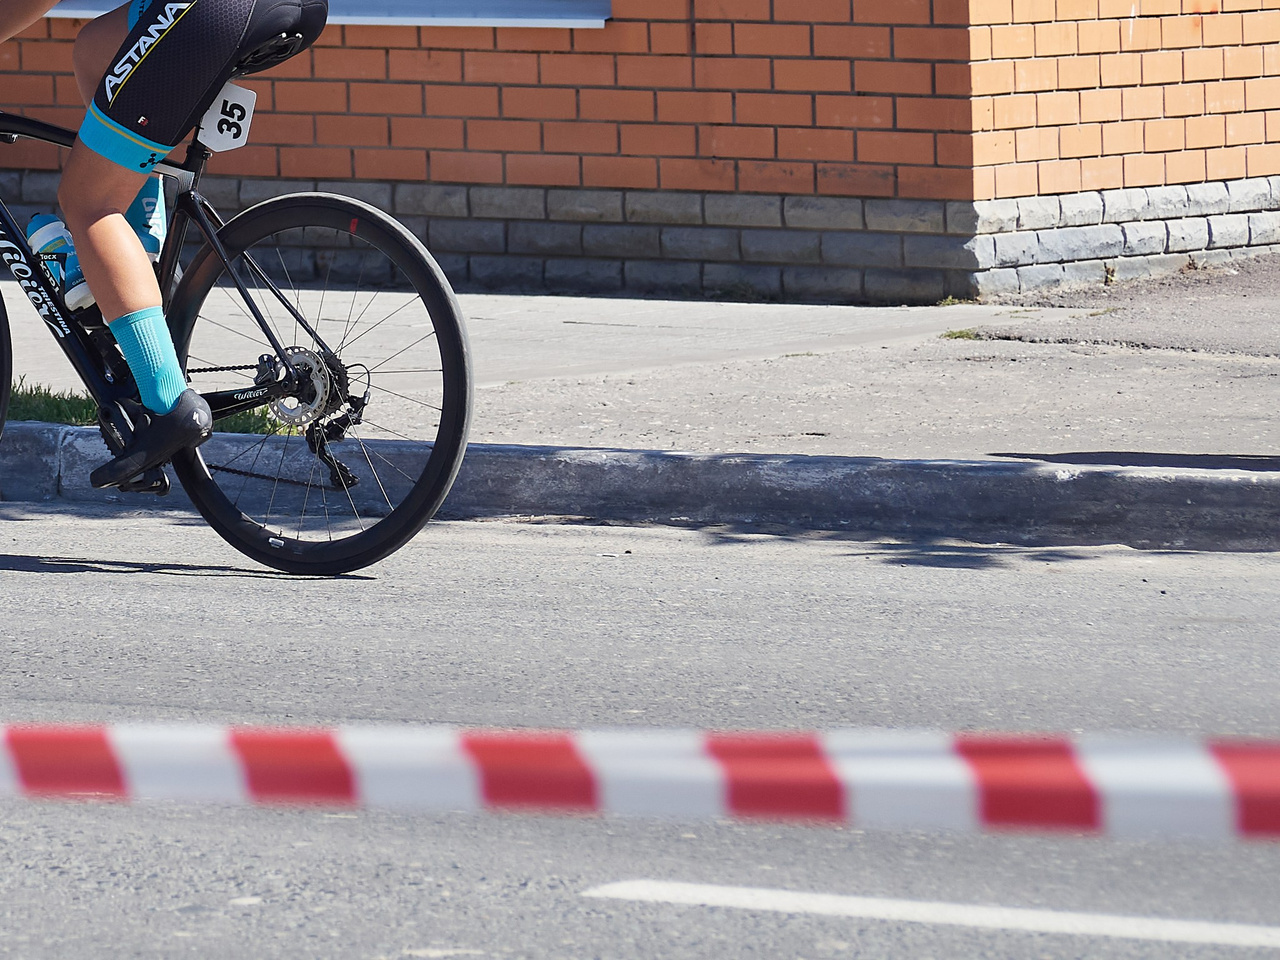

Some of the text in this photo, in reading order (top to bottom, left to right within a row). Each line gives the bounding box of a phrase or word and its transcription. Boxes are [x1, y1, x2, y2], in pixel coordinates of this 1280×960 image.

[105, 2, 192, 102] ASTANA
[216, 99, 246, 139] 35
[37, 286, 71, 335] TRIESTINA
